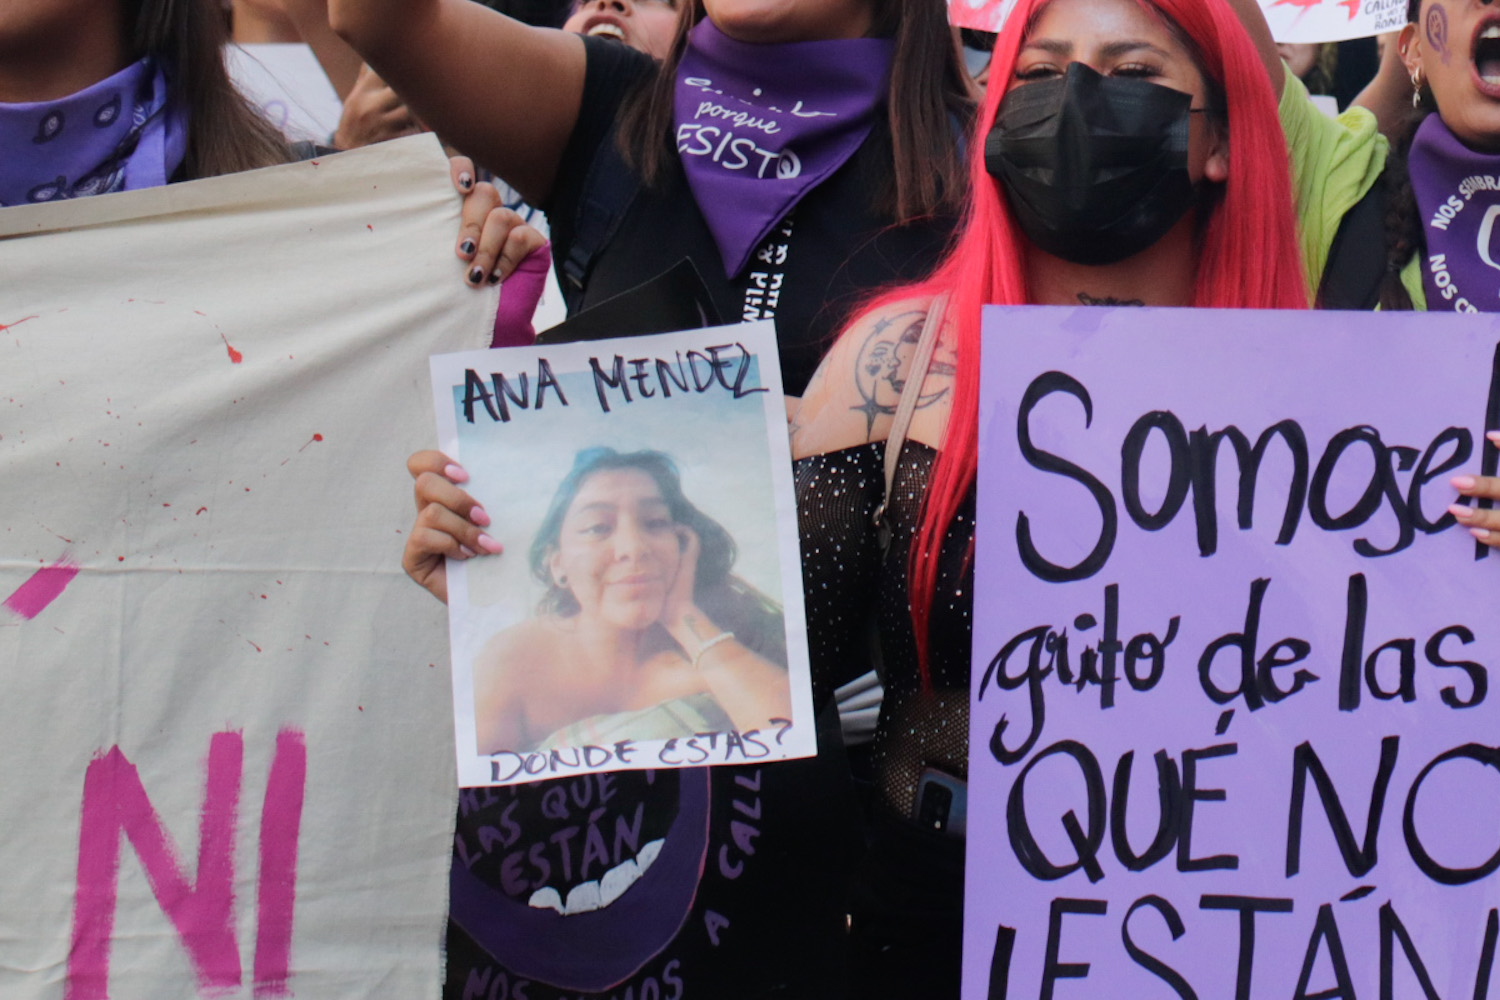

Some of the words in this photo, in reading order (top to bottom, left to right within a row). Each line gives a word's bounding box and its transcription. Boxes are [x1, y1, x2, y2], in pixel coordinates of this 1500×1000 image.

[694, 100, 782, 134] porque
[1430, 194, 1465, 231] NOS
[1429, 254, 1459, 300] NOS
[460, 357, 569, 424] ANA
[588, 342, 770, 413] MENDEZ
[1198, 576, 1321, 713] de
[1339, 572, 1489, 712] las
[489, 740, 638, 784] DONDE
[658, 717, 794, 766] ESTAS?
[454, 799, 522, 869] LAS
[541, 767, 620, 820] QUE
[1005, 708, 1240, 884] QUÉ
[500, 801, 646, 896] ESTÁN
[703, 909, 731, 947] A
